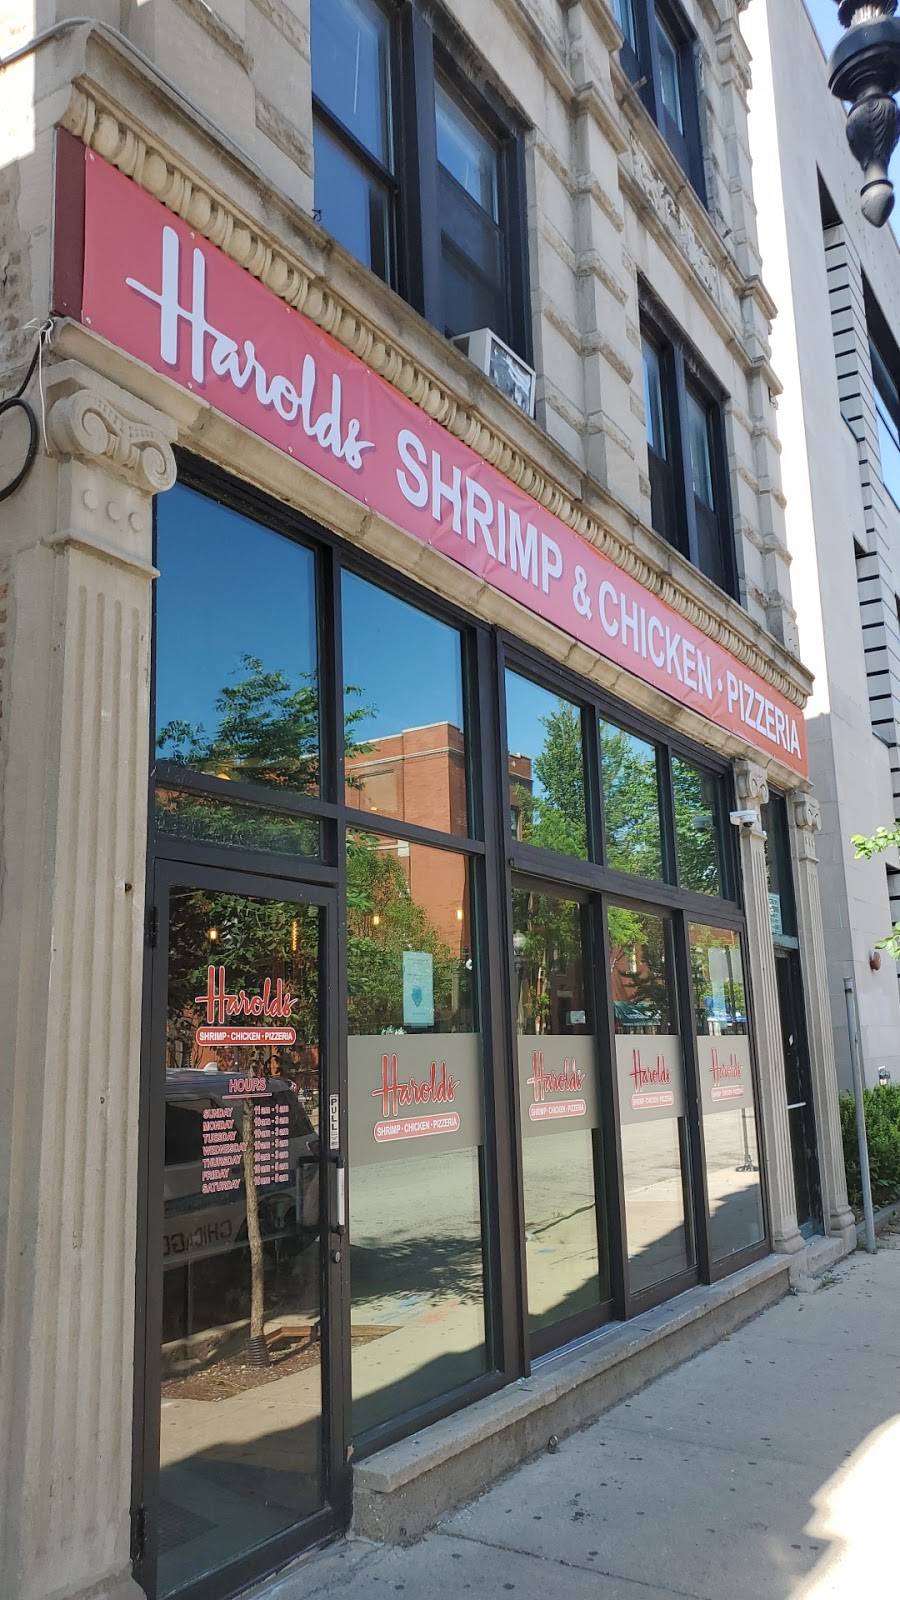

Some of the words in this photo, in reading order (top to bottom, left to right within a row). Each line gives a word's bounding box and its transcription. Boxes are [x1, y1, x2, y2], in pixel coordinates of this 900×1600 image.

[126, 226, 376, 470] Harolds
[396, 429, 564, 595] SHRIMP
[573, 565, 593, 619] &
[599, 580, 713, 701] CHICKEN
[726, 671, 802, 760] PIZZERIA
[194, 965, 298, 1025] Harolds
[199, 1032, 227, 1041] SHRIMP
[231, 1032, 261, 1041] CHICKEN
[264, 1032, 293, 1041] PIZZERIA
[527, 1050, 585, 1101] Harolds
[228, 1078, 267, 1093] HOURS
[371, 1054, 460, 1117] Harolds
[203, 1107, 233, 1119] SUNDAY
[203, 1119, 234, 1131] MONDAY
[377, 1124, 400, 1137] SHRIMP
[404, 1121, 430, 1133] CHICKEN
[203, 1131, 237, 1144] TUESDAY
[202, 1155, 241, 1168] THURSDAY
[202, 1168, 229, 1181] FRIDAY
[202, 1179, 240, 1194] SATURDAY
